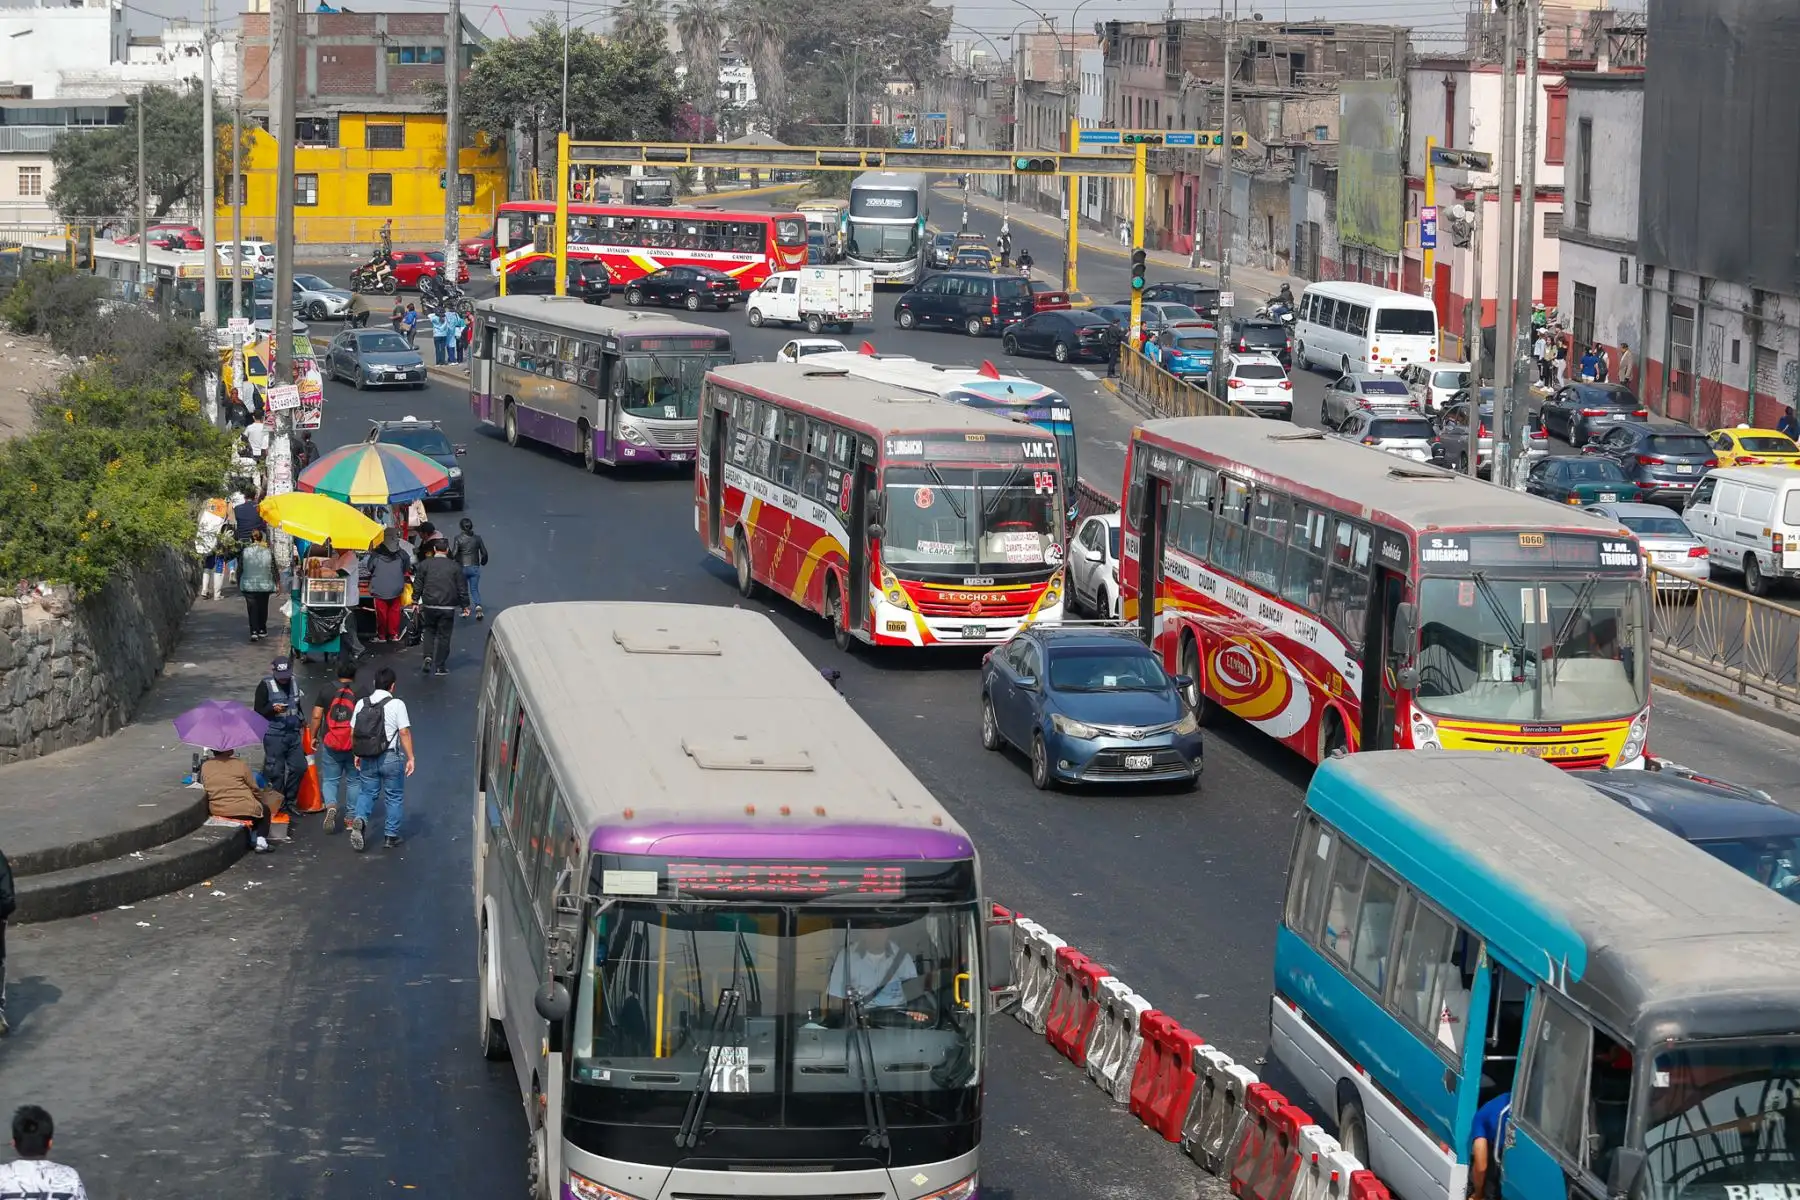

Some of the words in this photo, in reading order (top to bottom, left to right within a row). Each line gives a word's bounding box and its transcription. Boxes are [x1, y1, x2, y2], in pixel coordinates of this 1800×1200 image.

[1022, 442, 1056, 457] V.M.T.
[1521, 536, 1542, 545] 1060
[1381, 541, 1403, 561] Subida
[1603, 542, 1631, 553] V.M.
[1422, 549, 1469, 562] LURIGANCHO
[1600, 552, 1638, 566] TRIUNFO
[959, 593, 987, 601] OCHO
[1164, 555, 1190, 580] ESPERANZA
[1198, 573, 1217, 594] CIUDAD
[1225, 586, 1249, 608] AVIACION
[1258, 603, 1283, 623] ABANCAY
[1294, 619, 1319, 643] CAMPOY
[888, 622, 906, 632] 1060
